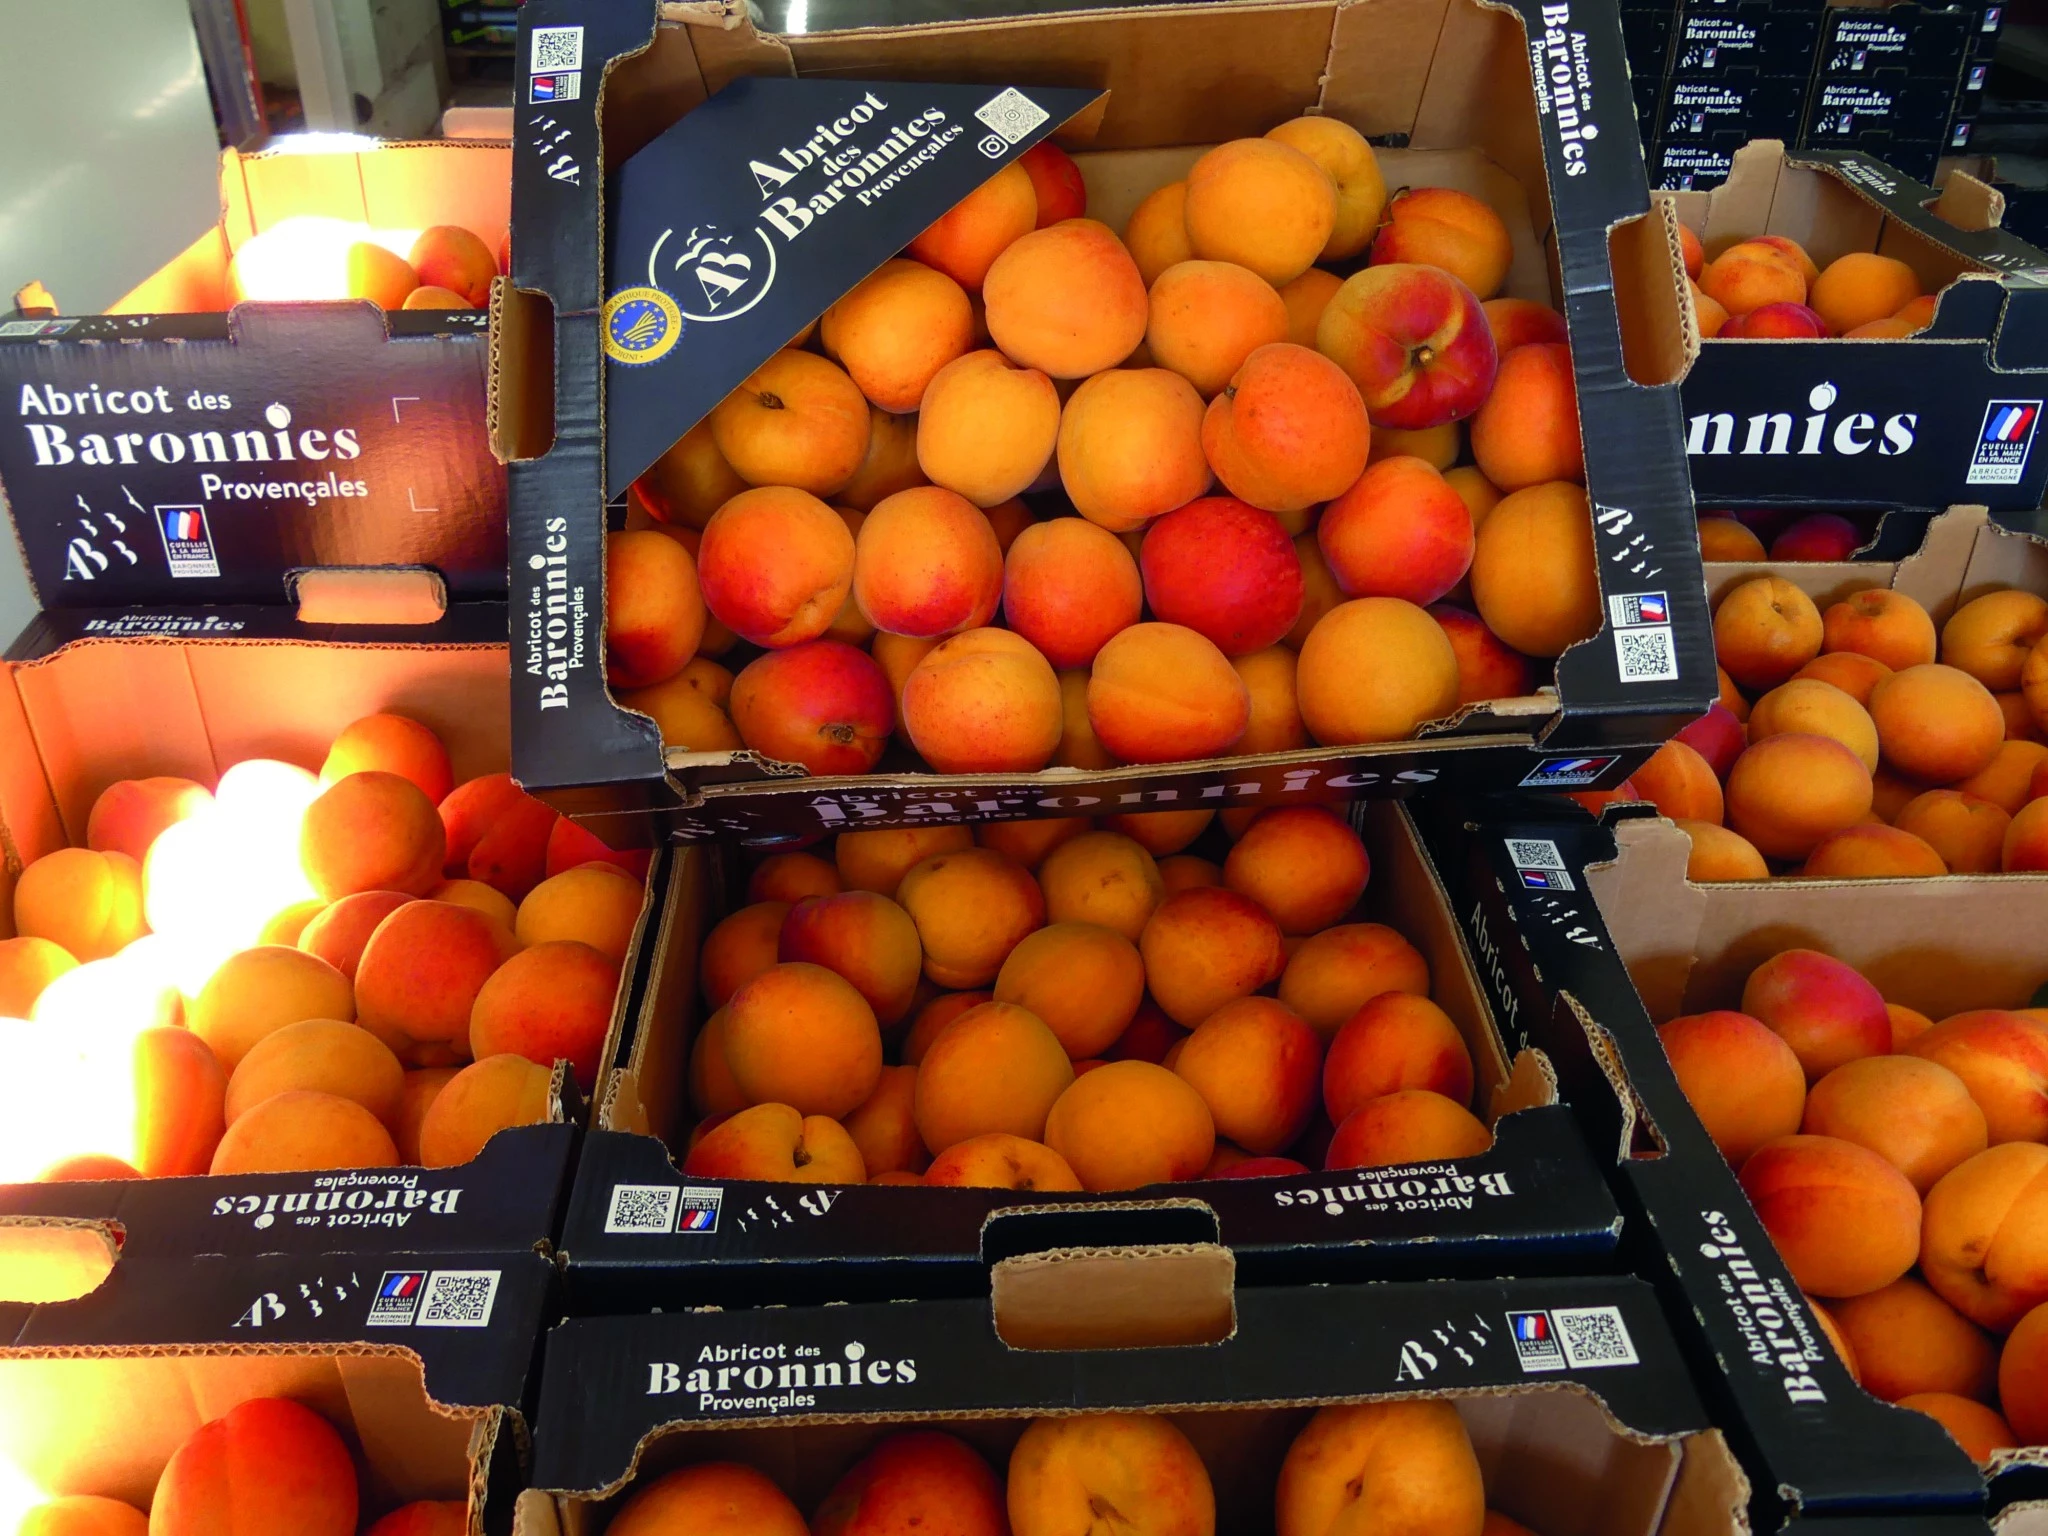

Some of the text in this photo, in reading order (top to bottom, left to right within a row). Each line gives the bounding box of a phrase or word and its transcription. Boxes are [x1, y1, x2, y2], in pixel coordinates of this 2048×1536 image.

[1685, 24, 1756, 39] Baronnies
[1835, 27, 1907, 42] Baronnies
[1530, 39, 1553, 115] Provençales
[1541, 2, 1599, 177] Baronnies
[1570, 32, 1592, 112] Abricot des
[1673, 89, 1743, 105] Baronnies
[1822, 91, 1892, 106] Baronnies
[749, 91, 889, 202] Abricot
[822, 145, 862, 177] des
[856, 124, 964, 207] Provençales
[1663, 152, 1730, 168] Baronnies
[759, 106, 946, 242] Baronnies
[20, 383, 232, 416] Abricot des
[1687, 381, 1919, 455] nnies
[24, 402, 361, 466] Baronnies
[201, 471, 368, 507] Provençales
[1971, 467, 2019, 475] ABRICOTS
[169, 541, 208, 549] CUEILLIS
[84, 616, 246, 631] Baronnies
[119, 614, 173, 622] Abricot
[526, 586, 542, 676] Abricot des
[528, 516, 569, 712] Baronnies
[568, 586, 589, 669] Provençales
[805, 769, 1441, 821] Baronnies
[810, 788, 1045, 805] Abricot des
[1470, 901, 1519, 1029] Abricot
[314, 1172, 419, 1191] Provençales
[1357, 1164, 1459, 1183] Provençales
[213, 1189, 464, 1230] Baronnies
[1274, 1172, 1515, 1216] Baronnies
[1364, 1196, 1473, 1213] Abricot des
[296, 1211, 412, 1228] Abricot des
[1700, 1210, 1828, 1405] Baronnies
[1717, 1273, 1775, 1365] Abricot des
[1768, 1277, 1824, 1362] Provençales
[645, 1340, 917, 1395] Baronnies
[697, 1343, 821, 1363] Abricot des
[699, 1389, 816, 1413] Provençales
